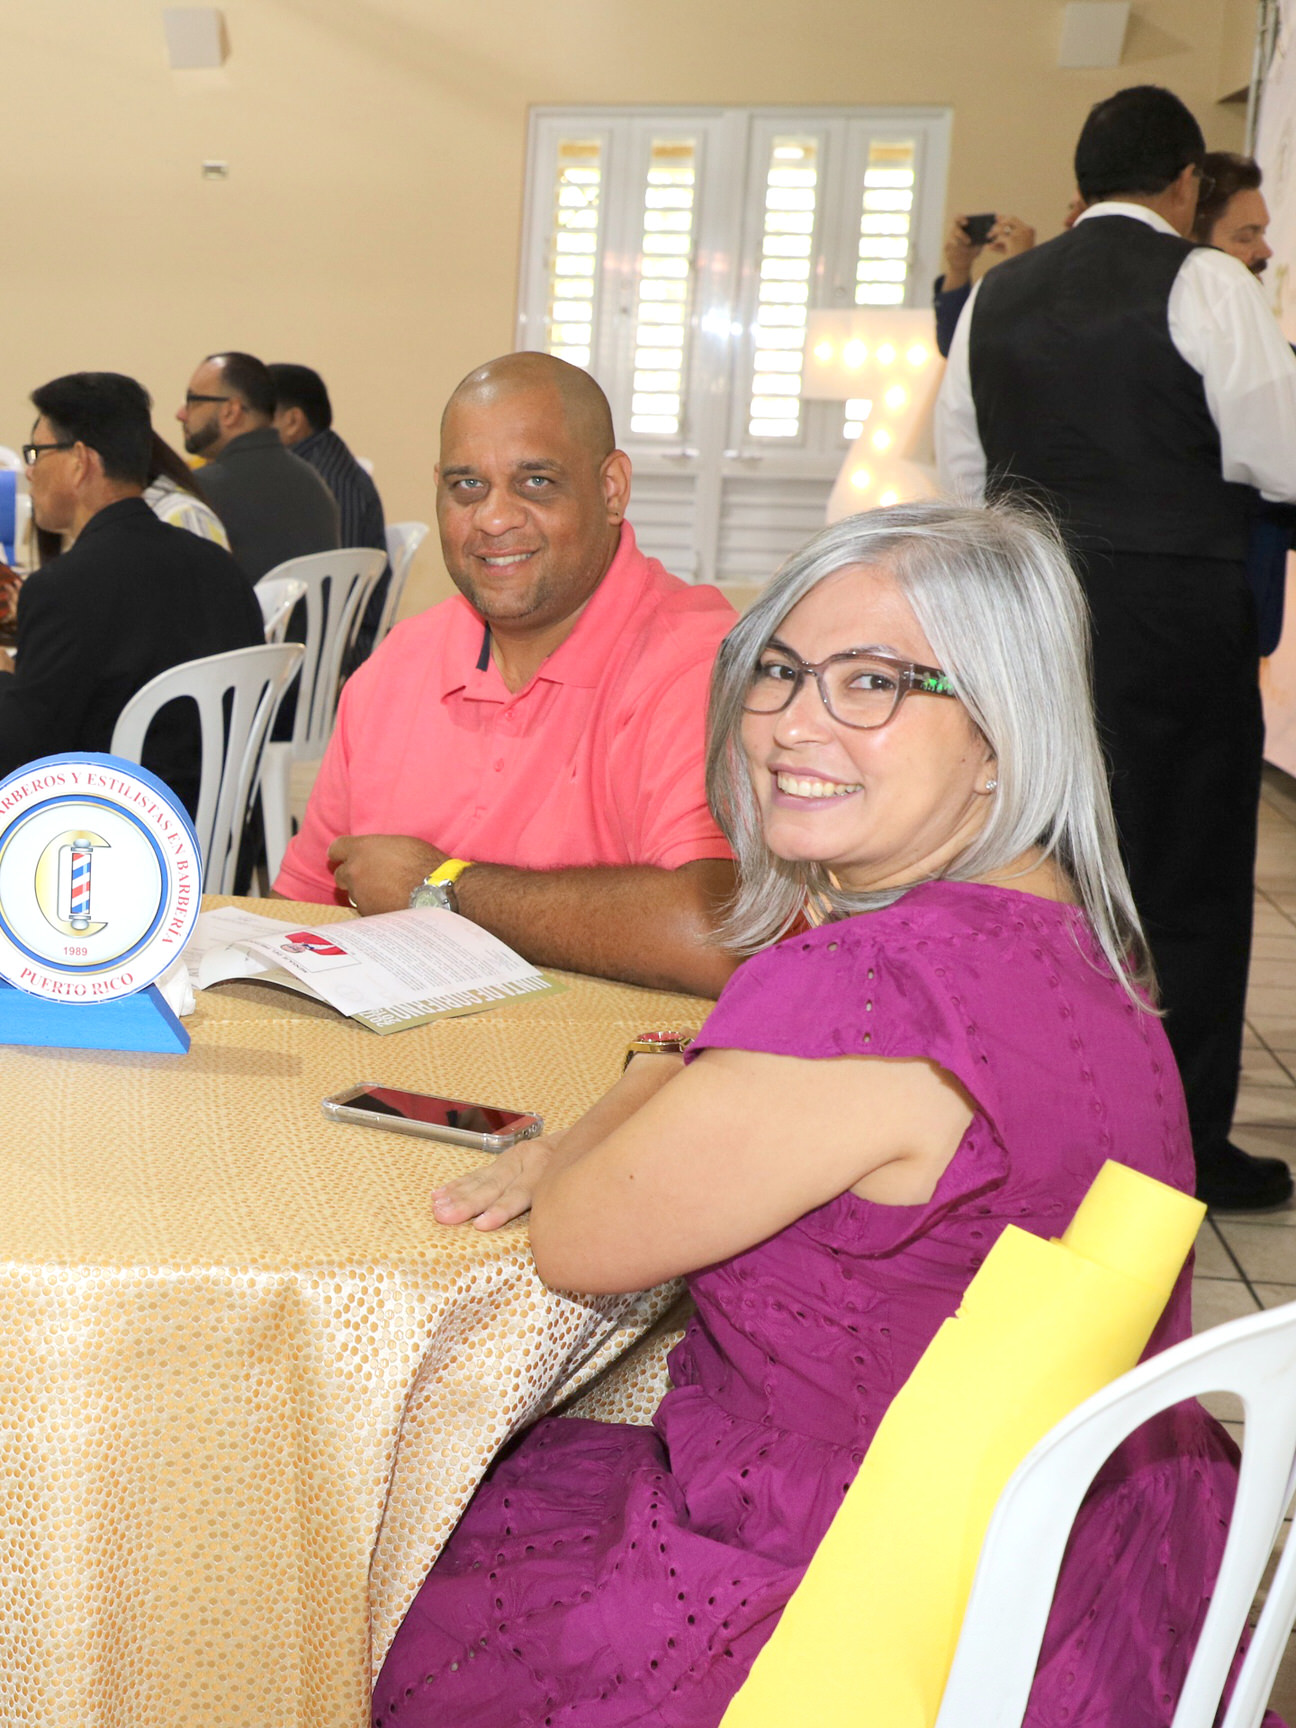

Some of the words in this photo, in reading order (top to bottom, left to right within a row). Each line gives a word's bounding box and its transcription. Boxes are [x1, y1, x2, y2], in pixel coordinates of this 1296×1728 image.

[71, 772, 82, 784] Y
[87, 772, 172, 831] ESTILISTAS
[167, 831, 185, 856] EN
[161, 860, 191, 945] BARBERÍA
[63, 946, 88, 956] 1989
[20, 967, 87, 996] PUERTO
[92, 972, 134, 996] RICO
